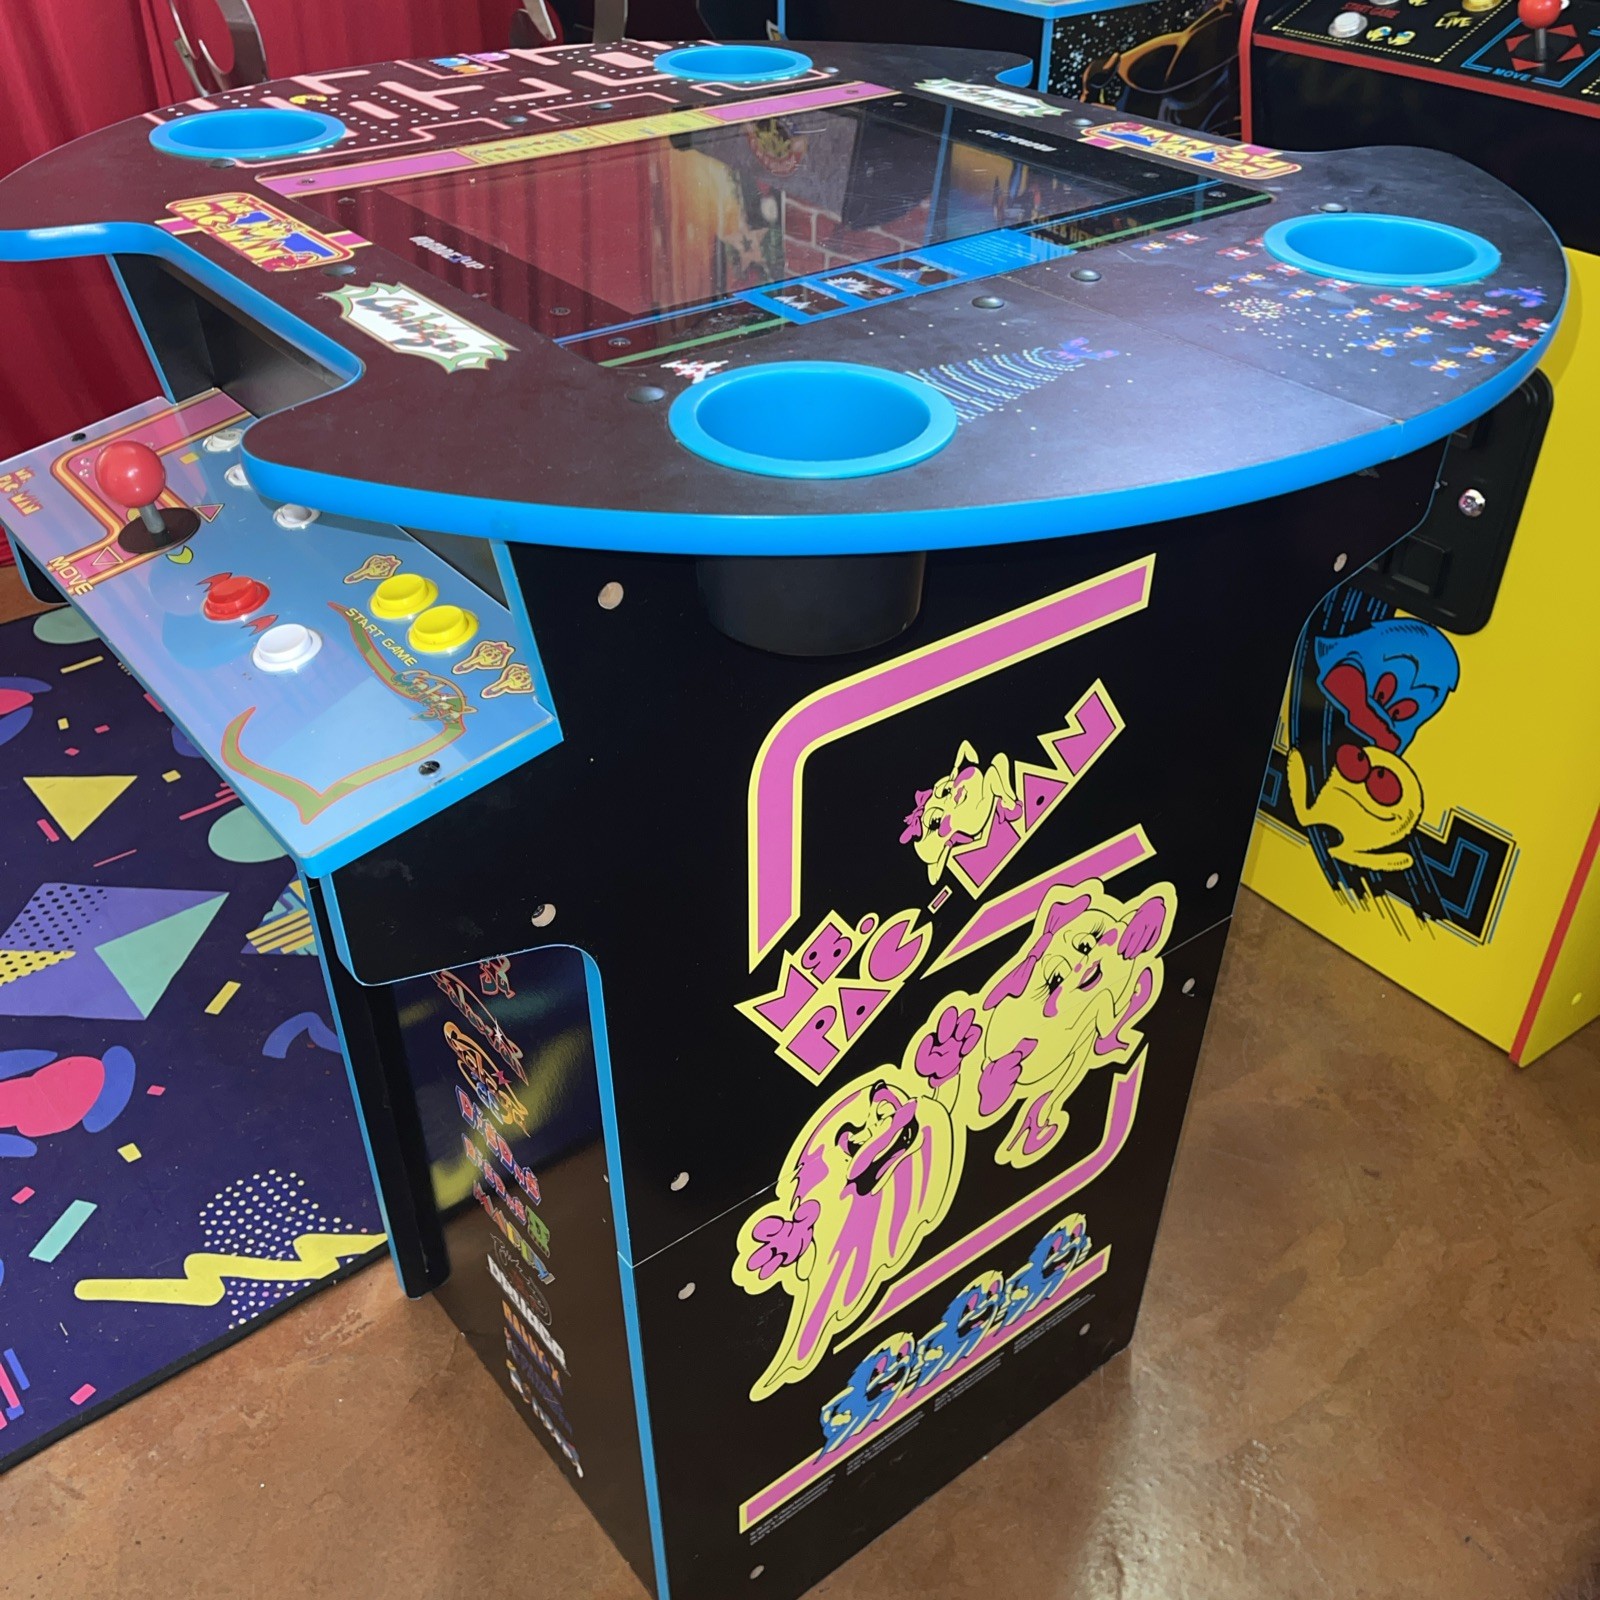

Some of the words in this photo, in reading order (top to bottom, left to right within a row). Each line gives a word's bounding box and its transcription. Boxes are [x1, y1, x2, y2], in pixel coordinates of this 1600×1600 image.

[1493, 68, 1531, 82] MOVE
[0, 474, 42, 516] PAC-MAN
[50, 555, 94, 597] MOVE
[345, 607, 385, 638] START
[381, 639, 419, 667] GAME
[775, 678, 1125, 1086] PAC-MAN
